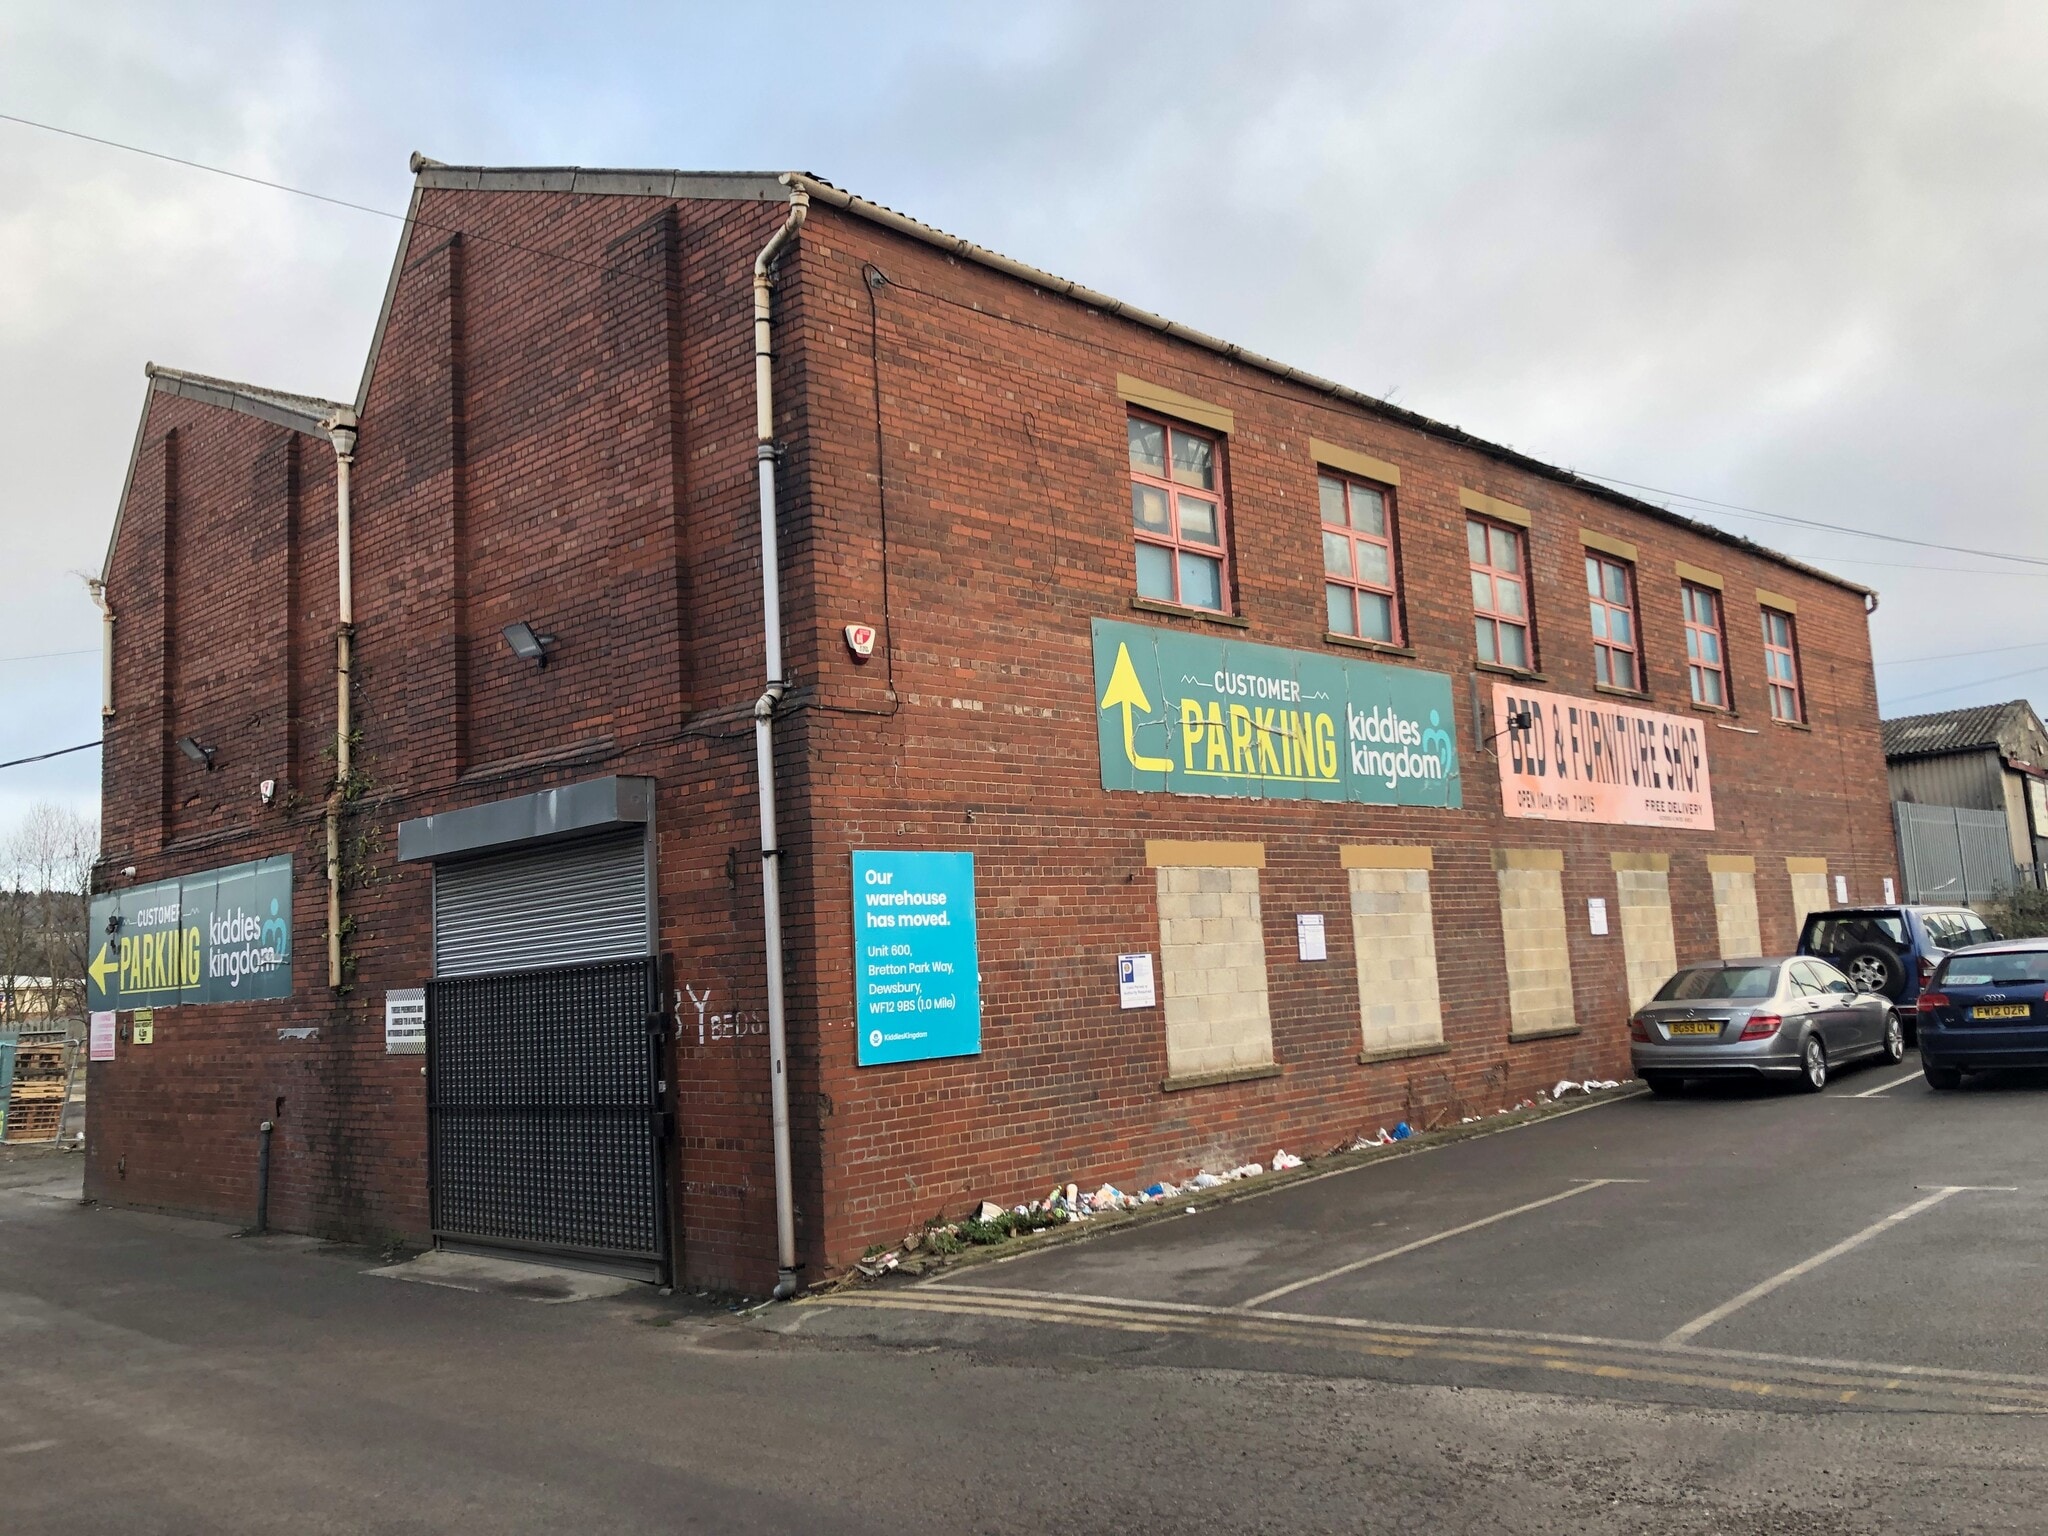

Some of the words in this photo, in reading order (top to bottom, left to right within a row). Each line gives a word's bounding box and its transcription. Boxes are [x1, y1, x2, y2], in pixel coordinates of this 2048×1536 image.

[1214, 670, 1300, 702] CUSTOMER
[1348, 702, 1421, 746] kiddies
[1180, 698, 1338, 778] PARKING
[1507, 696, 1546, 776] BED
[1552, 704, 1568, 778] &
[1568, 707, 1661, 789] FURNITURE
[1663, 723, 1699, 793] SHOP
[1352, 740, 1441, 789] kingdom
[1645, 799, 1665, 812] FREE
[1668, 801, 1703, 816] DELIVERY
[865, 869, 893, 885] Our
[866, 890, 947, 906] warehouse
[209, 907, 261, 946] kiddies
[867, 912, 895, 928] has
[898, 911, 951, 927] moved.
[120, 926, 200, 991] PARKING
[868, 945, 889, 957] Unit
[891, 944, 912, 957] 600,
[209, 946, 275, 987] kingdom
[868, 963, 907, 976] Bretton
[909, 961, 930, 974] Park
[932, 961, 954, 974] Way,
[869, 982, 922, 996] Dewsbury,
[870, 1001, 895, 1014] WF12
[897, 1000, 915, 1012] 9BS
[917, 996, 932, 1013] (1.0
[933, 993, 956, 1010] Mile)
[1976, 1006, 2001, 1017] FW12
[2003, 1005, 2025, 1016] OZR
